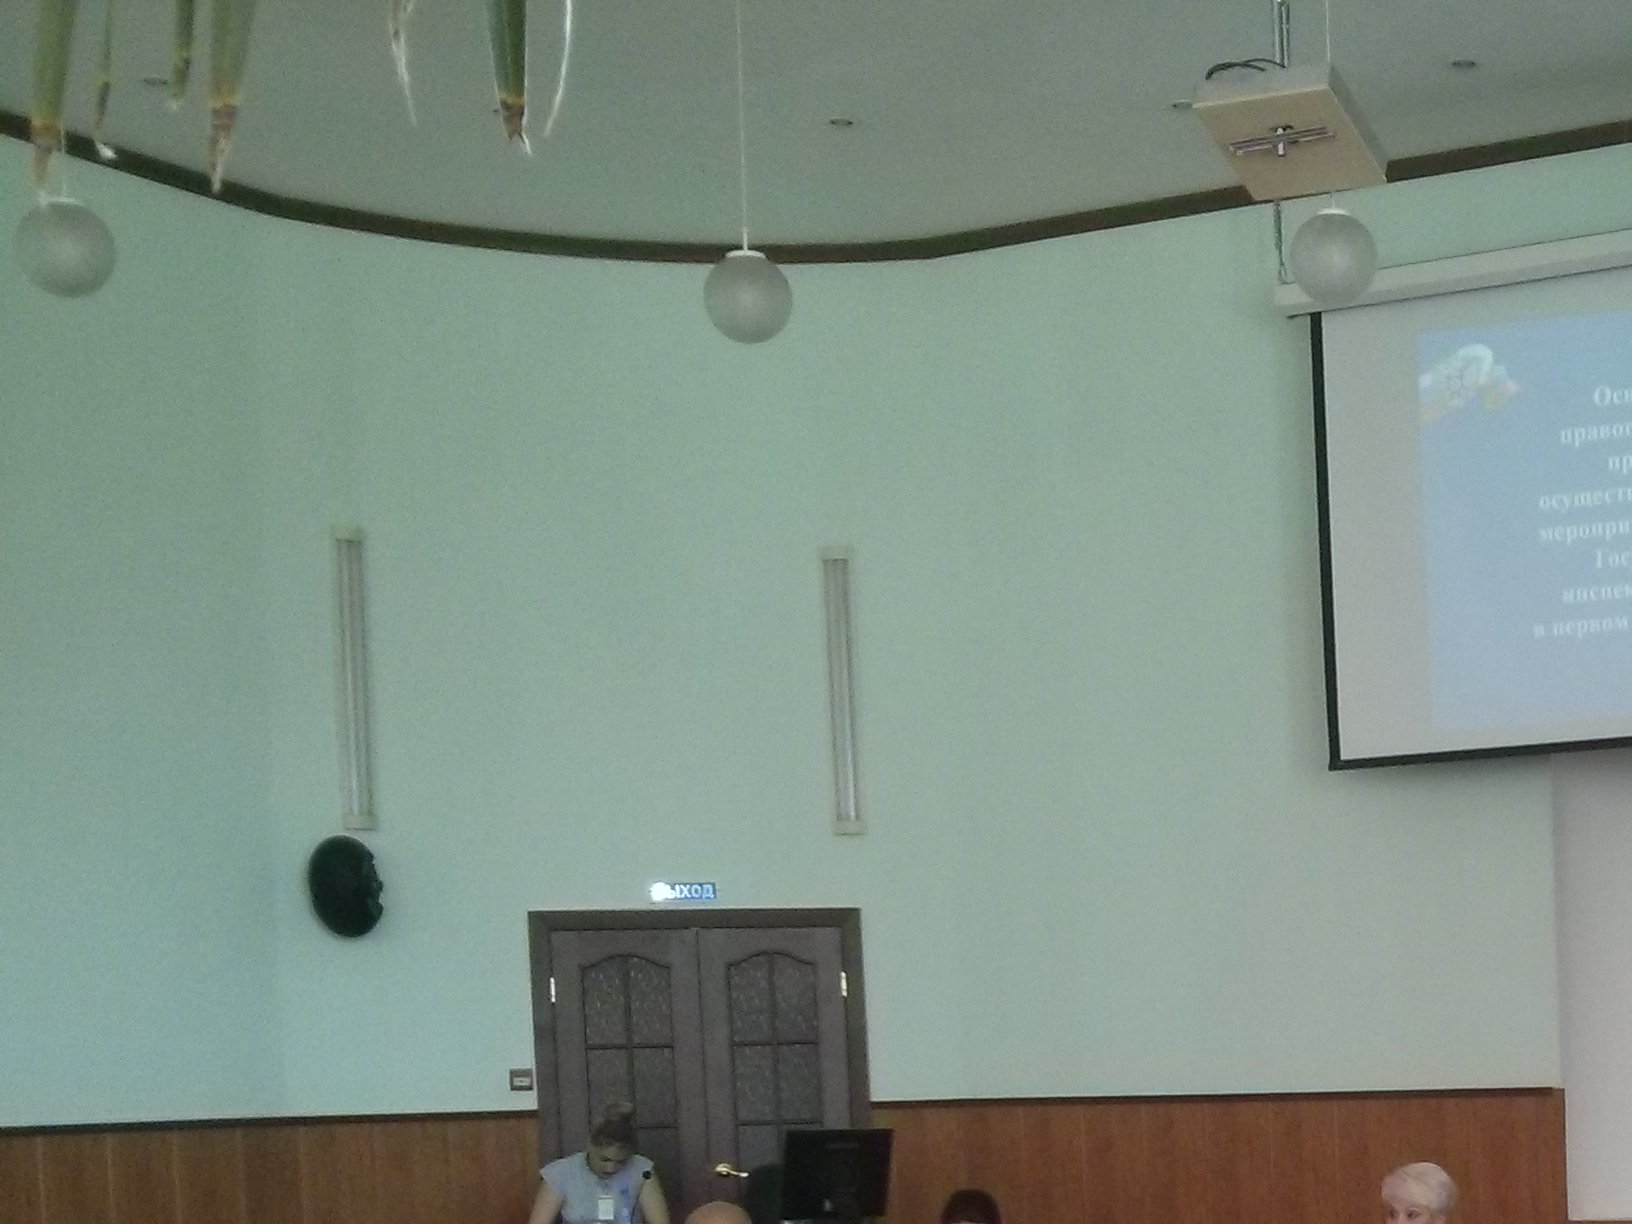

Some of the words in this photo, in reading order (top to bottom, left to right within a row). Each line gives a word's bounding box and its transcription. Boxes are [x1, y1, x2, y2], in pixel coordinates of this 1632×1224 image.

[1533, 622, 1545, 638] в
[1554, 614, 1629, 639] первом
[653, 883, 715, 899] ЫХОД
